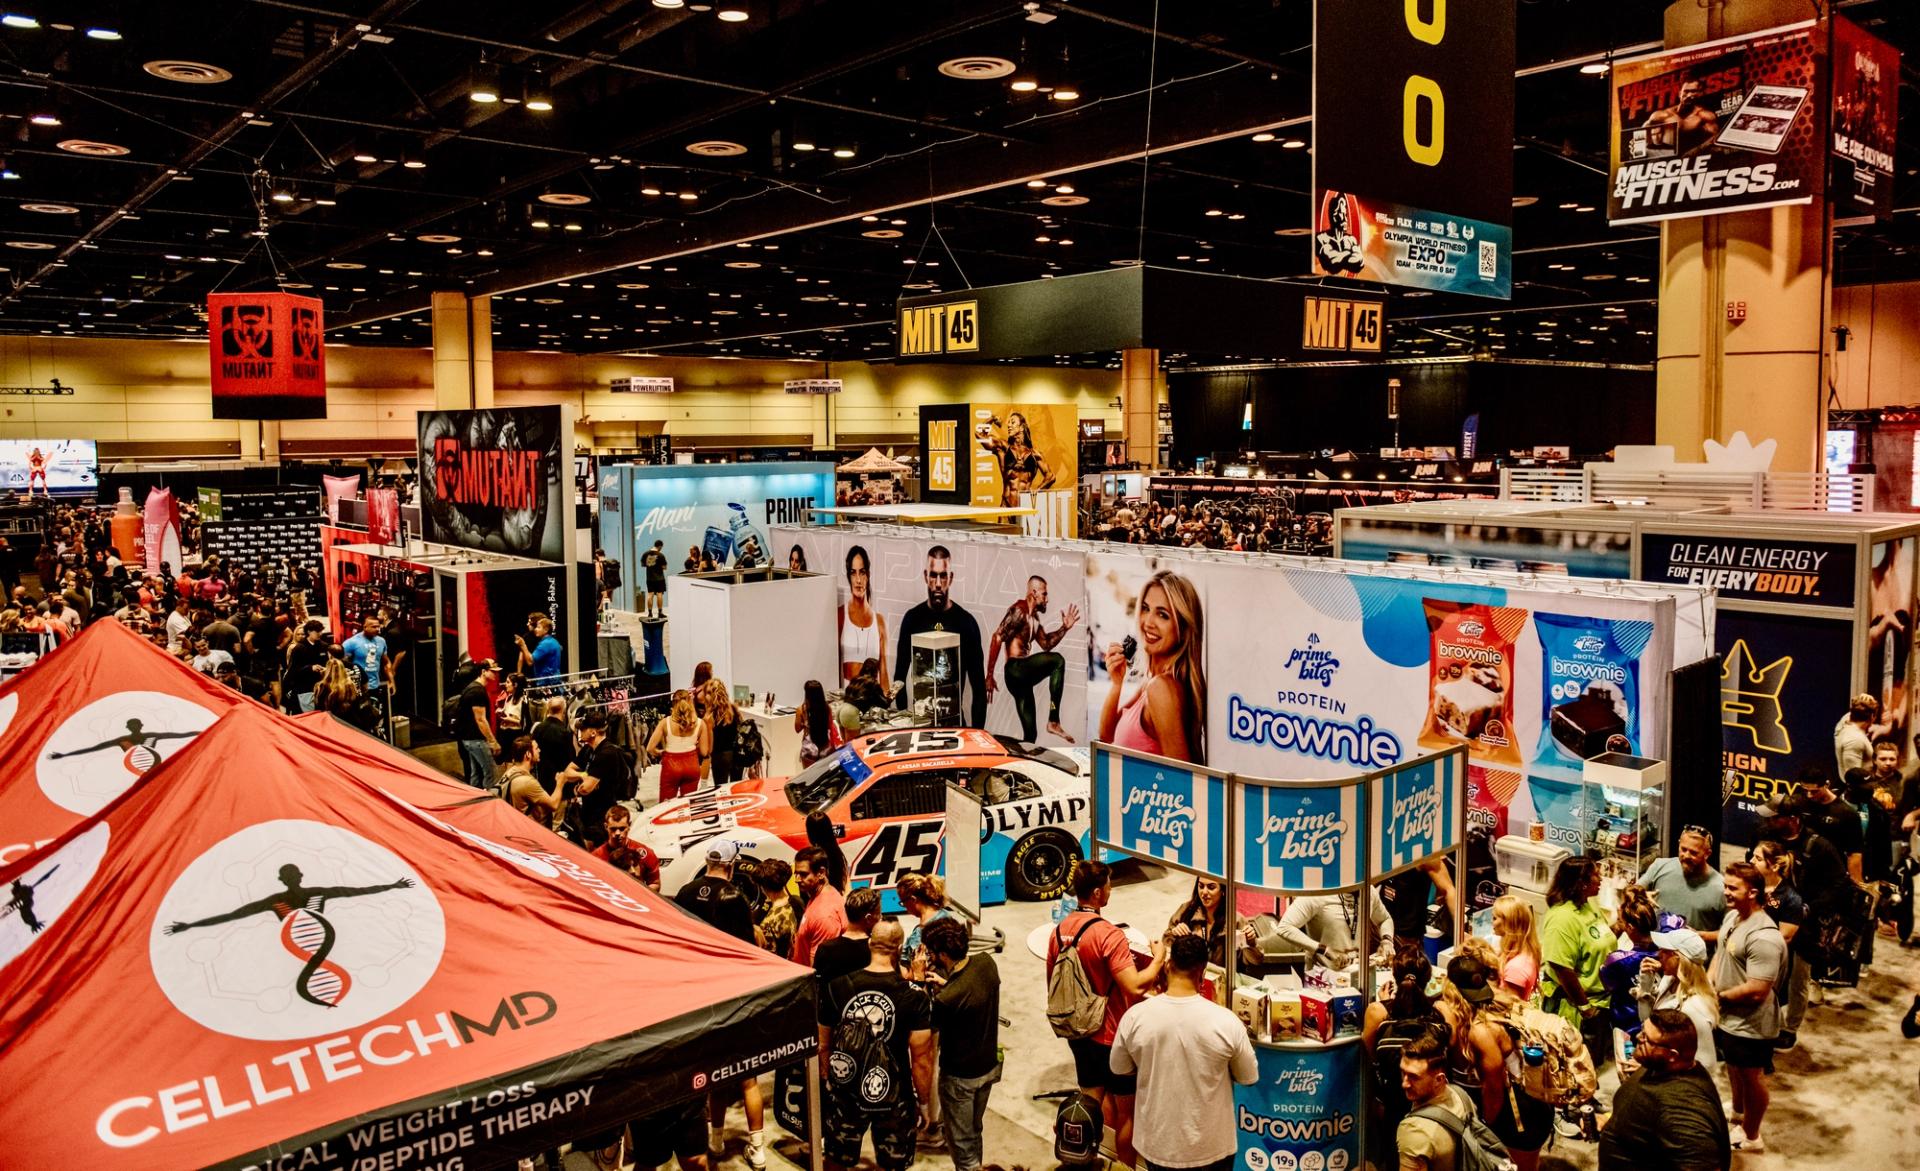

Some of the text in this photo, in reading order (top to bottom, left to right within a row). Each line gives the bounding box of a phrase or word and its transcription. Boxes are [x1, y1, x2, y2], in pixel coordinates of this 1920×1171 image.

[1721, 95, 1743, 109] GEAR
[1834, 132, 1894, 173] WE ARE OLYMPIA
[1616, 154, 1711, 185] MUSCLE
[1397, 217, 1413, 229] FLEX
[1384, 231, 1466, 253] OLYMPIA WORLD FITNESS
[1408, 244, 1445, 264] EXPO
[1396, 259, 1411, 268] 10AM
[1416, 262, 1428, 271] 5PM
[902, 304, 974, 355] MIT 45
[1304, 297, 1378, 349] MIT 45
[222, 362, 273, 379] MUTANT
[633, 384, 672, 392] POWERLIFTING
[928, 420, 957, 450] MIT
[462, 450, 542, 510] MUTANT
[932, 456, 953, 485] 45
[1414, 464, 1438, 476] RAW
[1471, 462, 1493, 473] RAW
[602, 496, 619, 512] PRIME
[766, 497, 816, 525] PRIME
[1018, 491, 1073, 539] MIT
[634, 502, 699, 540] Alani
[1669, 543, 1828, 571] CLEAN ENERGY
[1667, 566, 1820, 596] FOR EVERYBODY.
[1438, 641, 1503, 665] brownie
[1456, 637, 1485, 647] PROTEIN
[1284, 645, 1332, 668] prime
[1552, 656, 1627, 684] brownie
[1572, 653, 1605, 662] PROTEIN
[1298, 659, 1340, 688] bites
[1278, 691, 1346, 714] PROTEIN
[865, 730, 965, 758] 45
[1230, 696, 1401, 768] brownie
[1121, 783, 1185, 814] prime
[1387, 784, 1435, 835] prime
[1140, 807, 1196, 848] bites
[1255, 809, 1336, 844] prime
[1401, 792, 1442, 842] bites
[853, 819, 946, 887] 45
[1014, 836, 1035, 864] EAGLE
[1280, 820, 1348, 864] bites
[846, 995, 892, 1021] BLACK SKULL
[95, 991, 557, 1149] CELLTECHMD
[711, 1036, 818, 1083] CELLTECHMDATL
[1275, 1067, 1317, 1085] prime
[1288, 1073, 1324, 1096] bites
[348, 1100, 463, 1152] WEIGHT
[471, 1081, 536, 1113] LOSS
[481, 1085, 595, 1140] THERAPY
[1239, 1103, 1354, 1142] brownie
[1273, 1104, 1324, 1114] PROTEIN
[1251, 1151, 1264, 1165] 5g
[1275, 1155, 1294, 1166] 19g
